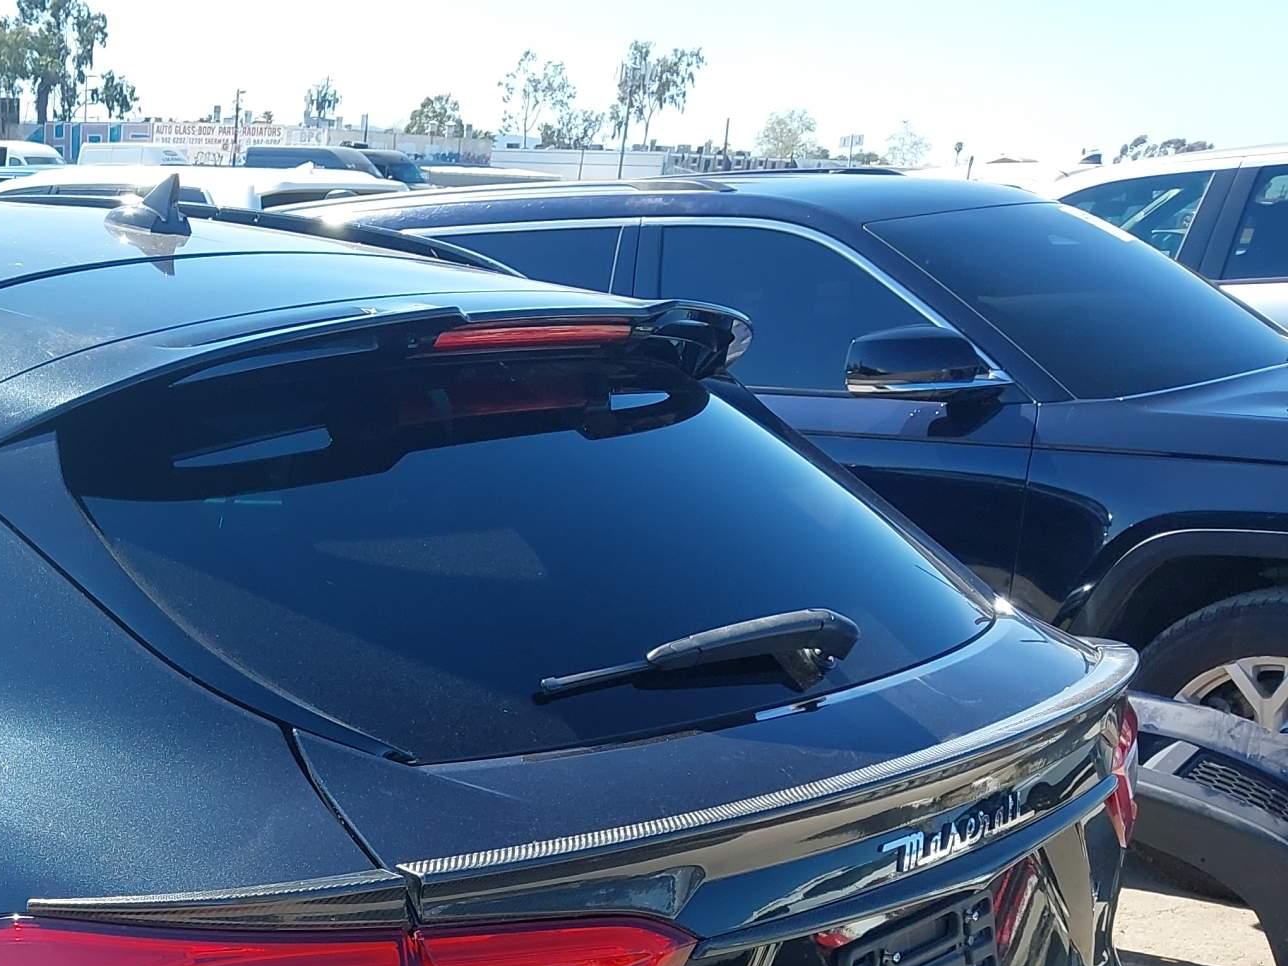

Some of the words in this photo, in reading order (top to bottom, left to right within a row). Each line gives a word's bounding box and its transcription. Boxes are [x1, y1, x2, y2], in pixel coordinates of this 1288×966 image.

[156, 125, 173, 135] AUTO
[174, 125, 196, 136] GLASS
[197, 126, 215, 136] BODY
[242, 127, 282, 138] RADIATORS
[882, 791, 1035, 872] Maserati
